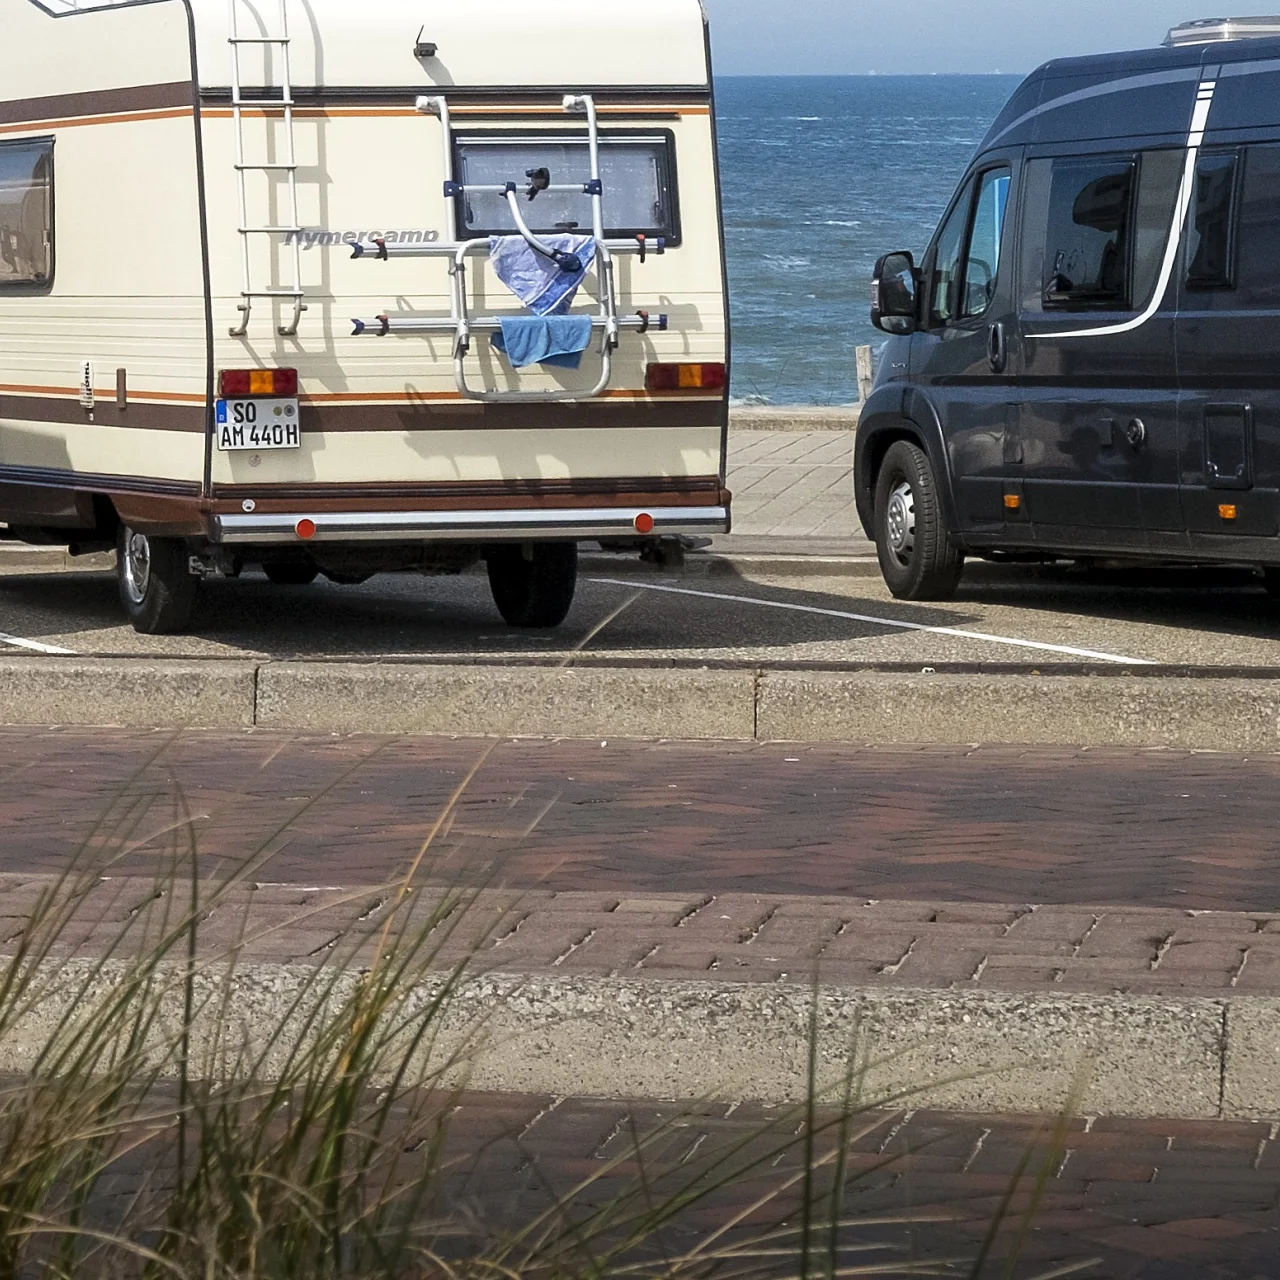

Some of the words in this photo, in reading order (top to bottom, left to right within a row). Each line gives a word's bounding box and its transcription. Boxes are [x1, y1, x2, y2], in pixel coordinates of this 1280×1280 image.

[233, 402, 257, 423] SO
[221, 425, 245, 447] AM
[250, 423, 298, 446] 440H
